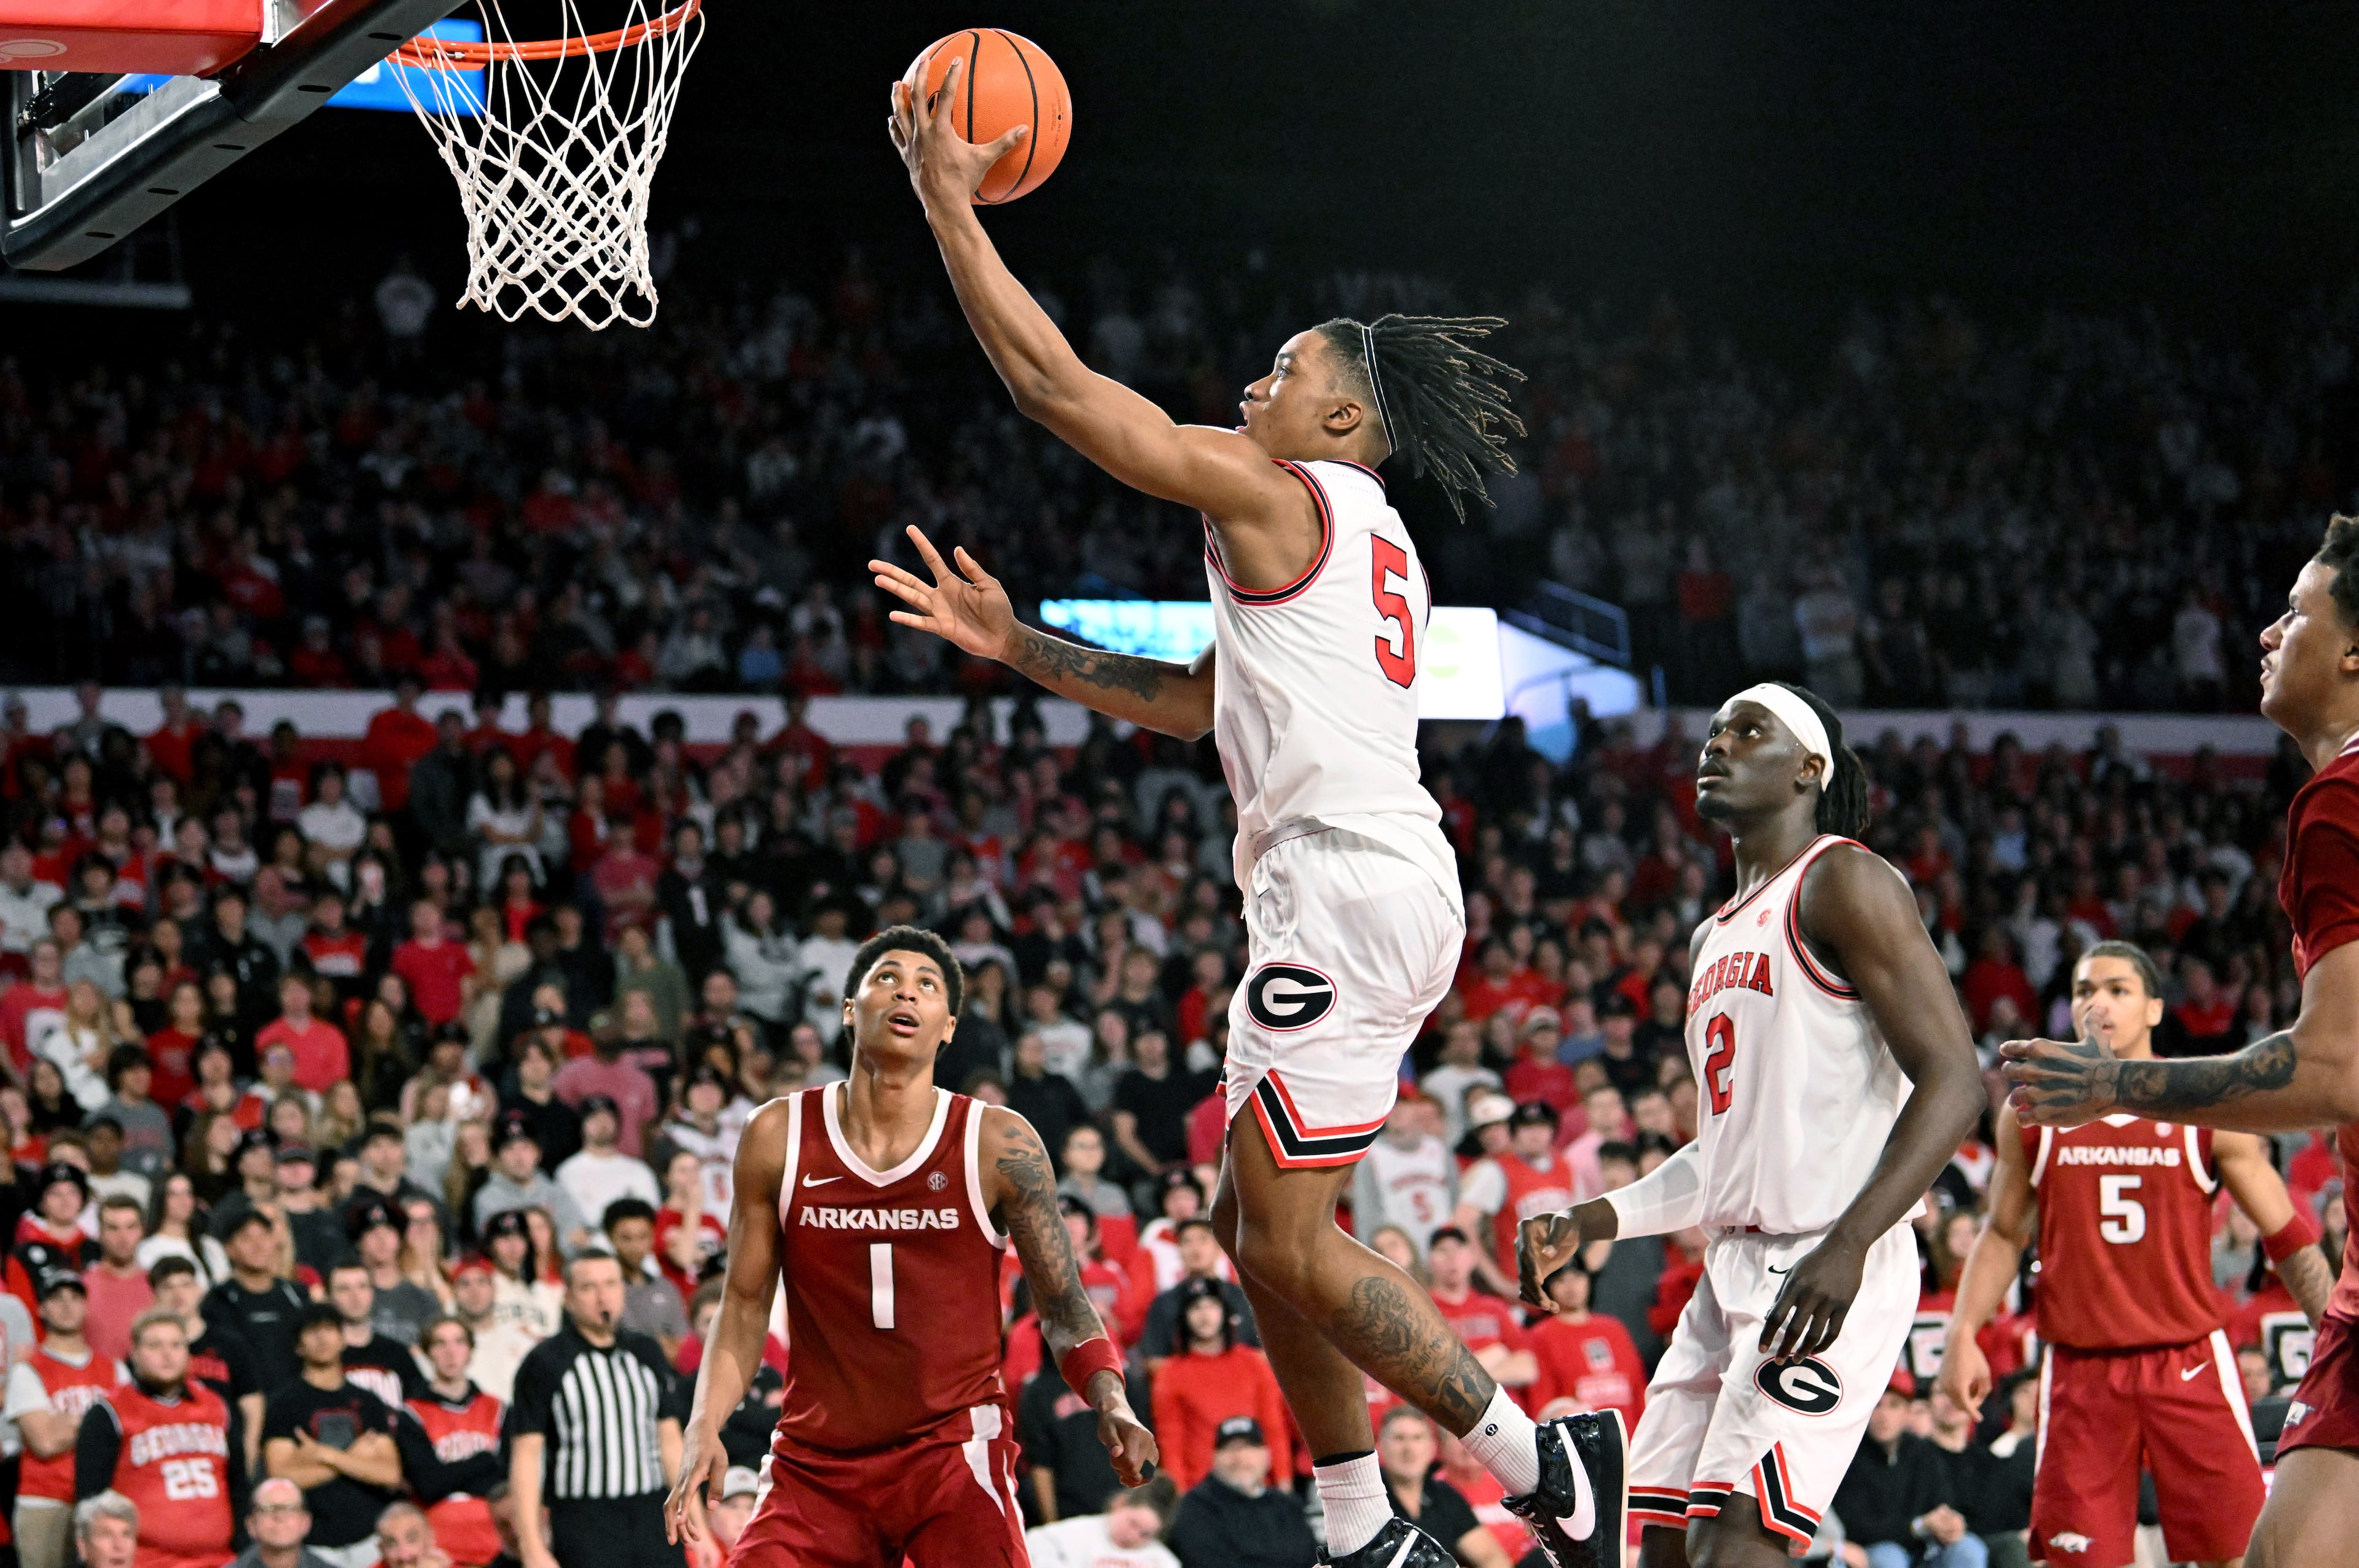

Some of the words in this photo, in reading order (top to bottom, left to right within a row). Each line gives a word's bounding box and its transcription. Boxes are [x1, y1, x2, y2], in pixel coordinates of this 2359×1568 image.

[1371, 532, 1416, 689] 5
[1247, 966, 1333, 1028] G
[1705, 1012, 1735, 1116] 2
[929, 1173, 947, 1190] SEC
[2057, 1145, 2180, 1167] ARKANSAS
[799, 1206, 959, 1230] ARKANSAS
[2100, 1174, 2146, 1244] 5
[870, 1242, 894, 1330] 1
[1758, 1354, 1841, 1413] G
[161, 1457, 219, 1501] 25
